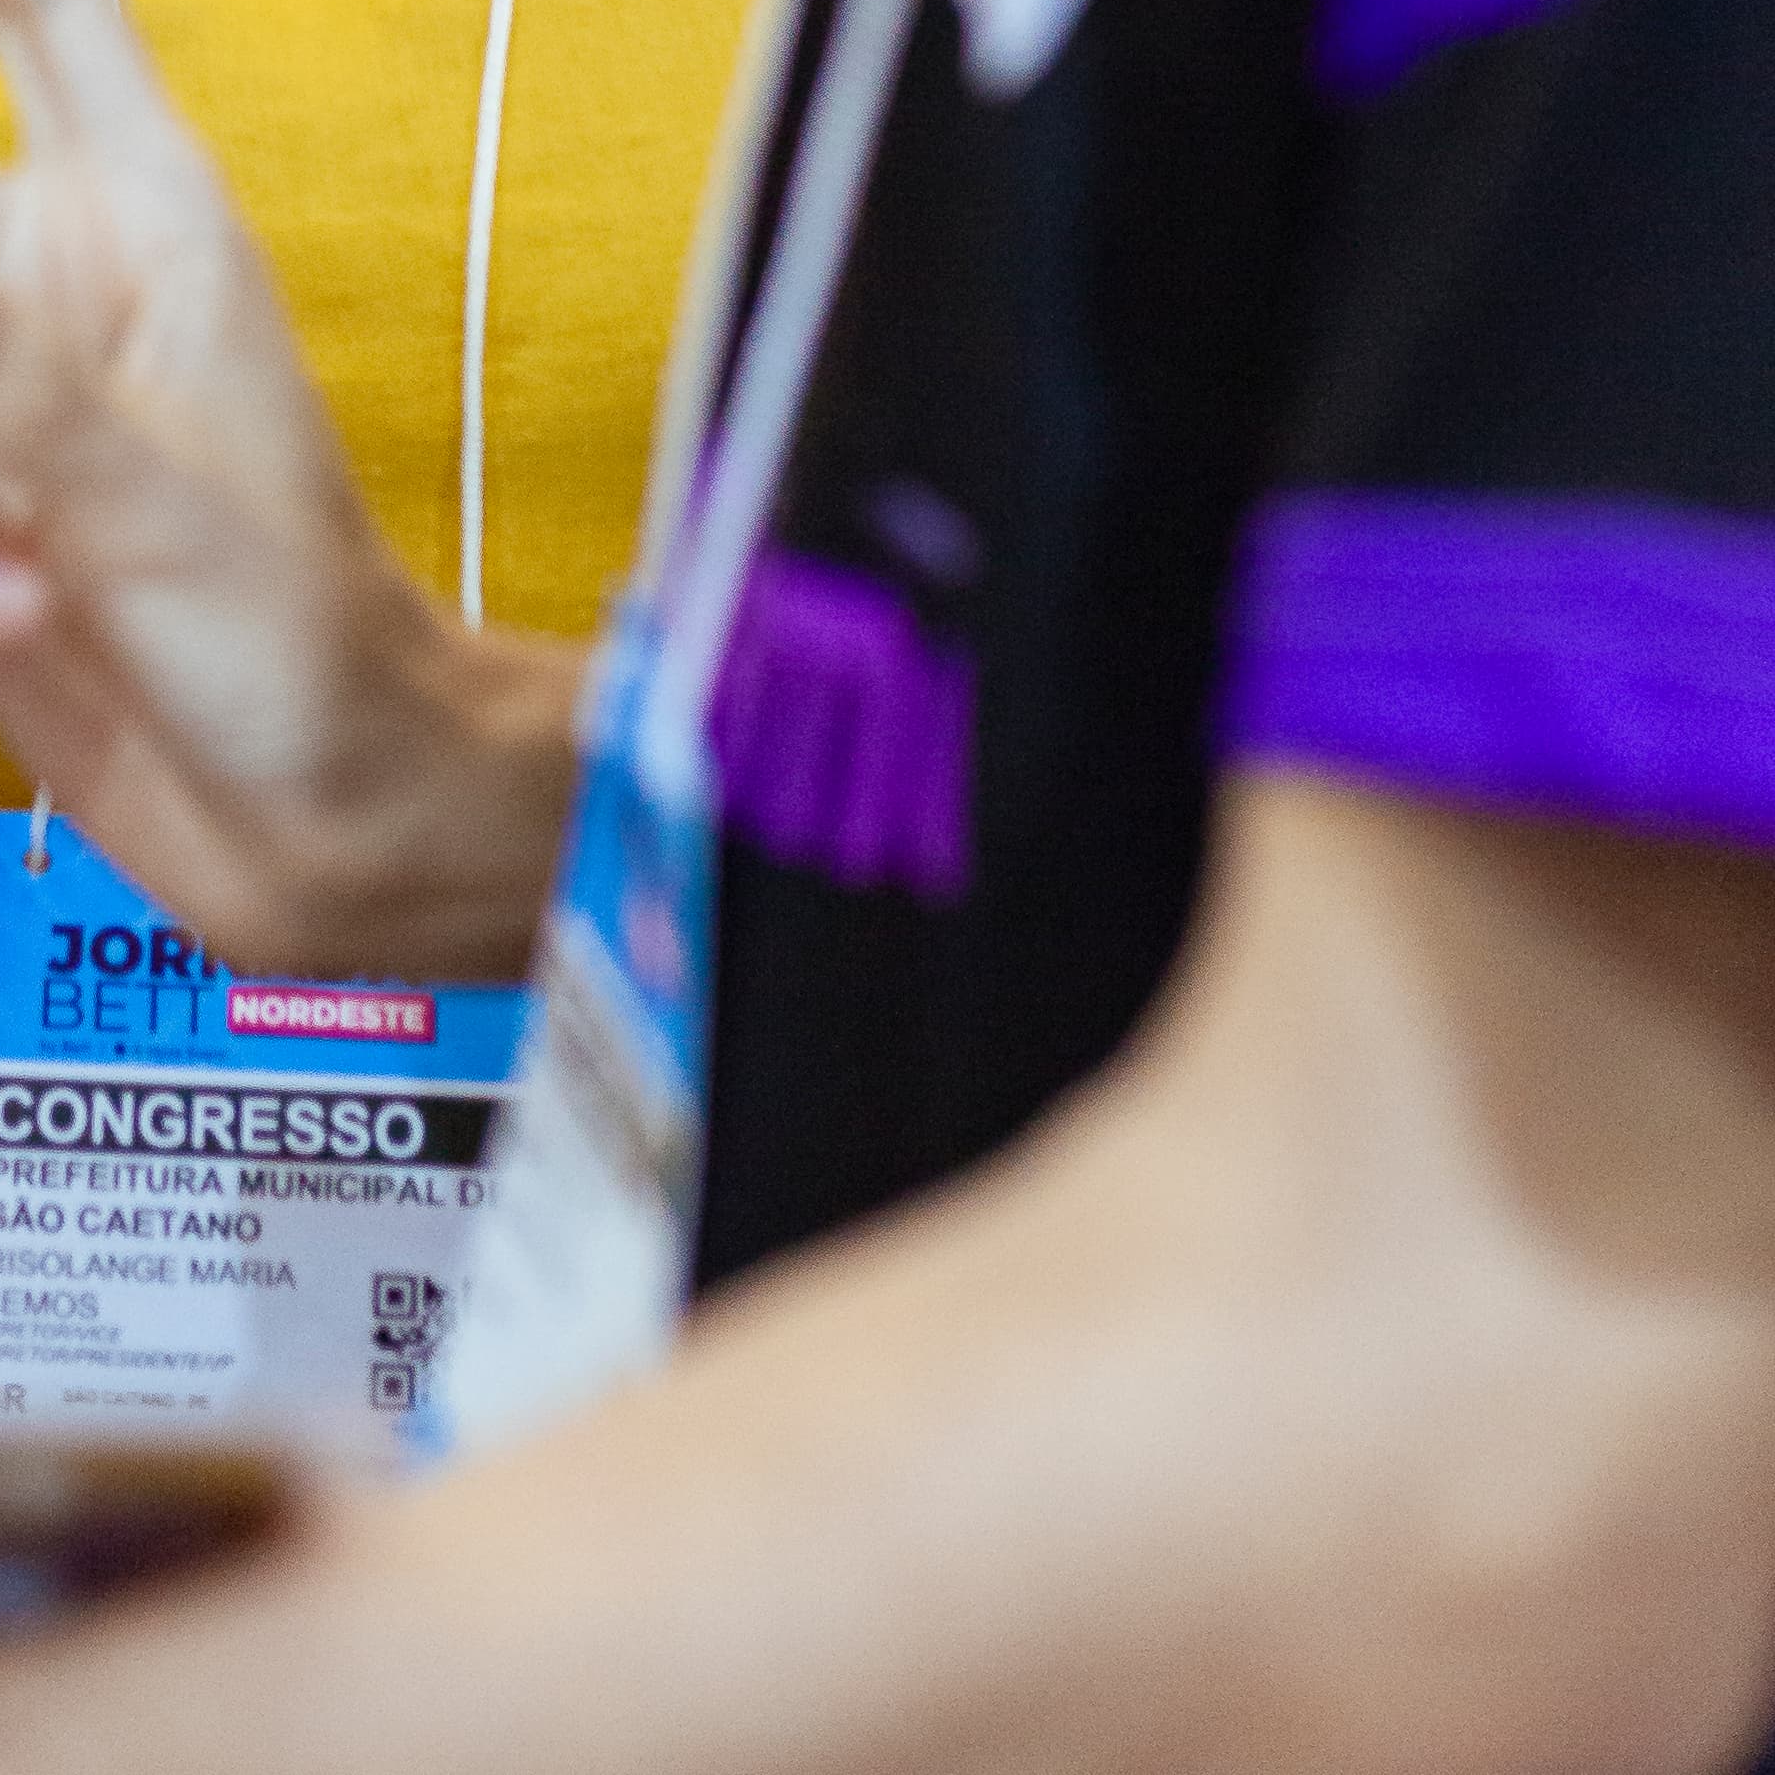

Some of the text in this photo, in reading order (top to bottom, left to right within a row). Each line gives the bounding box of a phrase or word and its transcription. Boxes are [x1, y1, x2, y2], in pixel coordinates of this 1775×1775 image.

[47, 923, 218, 978] JOR
[41, 976, 216, 1037] BETT
[231, 993, 426, 1034] NORDESTE
[238, 1168, 447, 1208] MUNICIPAL
[77, 1203, 263, 1245] CAETANO
[189, 1255, 299, 1292] MARIA
